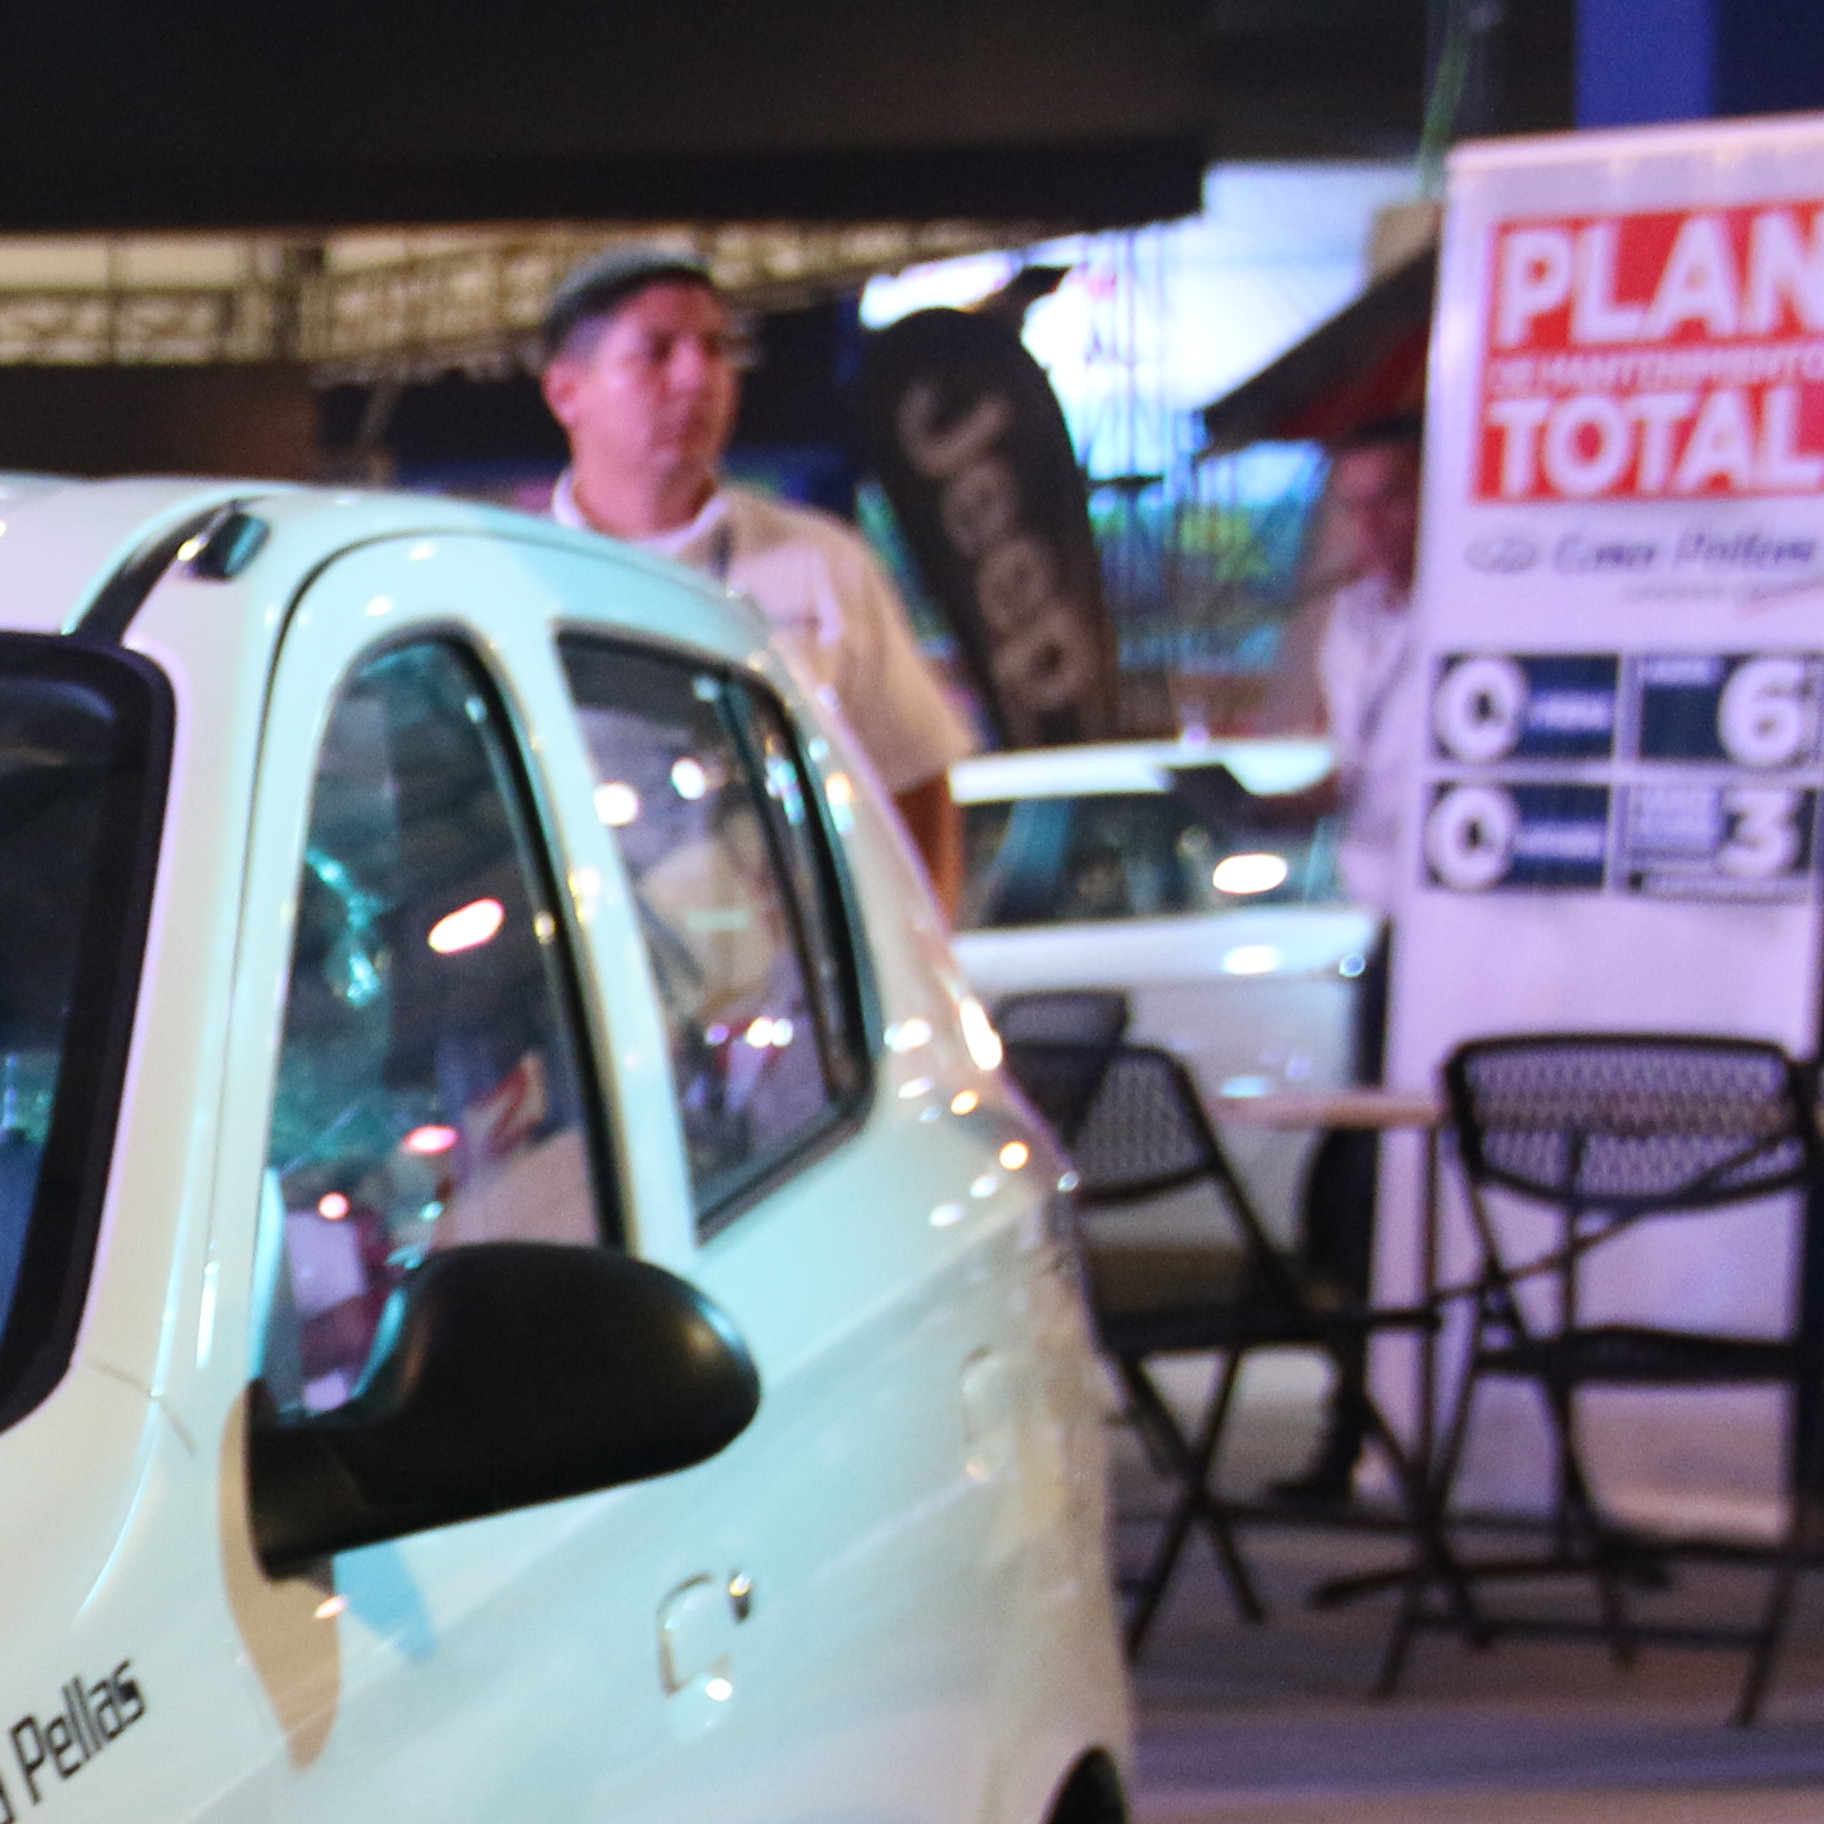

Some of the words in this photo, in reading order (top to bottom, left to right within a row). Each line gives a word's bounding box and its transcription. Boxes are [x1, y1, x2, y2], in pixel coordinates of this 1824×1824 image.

[1494, 206, 1824, 348] PLAN
[1487, 384, 1824, 494] TOTAL
[8, 1658, 148, 1807] Pellas
